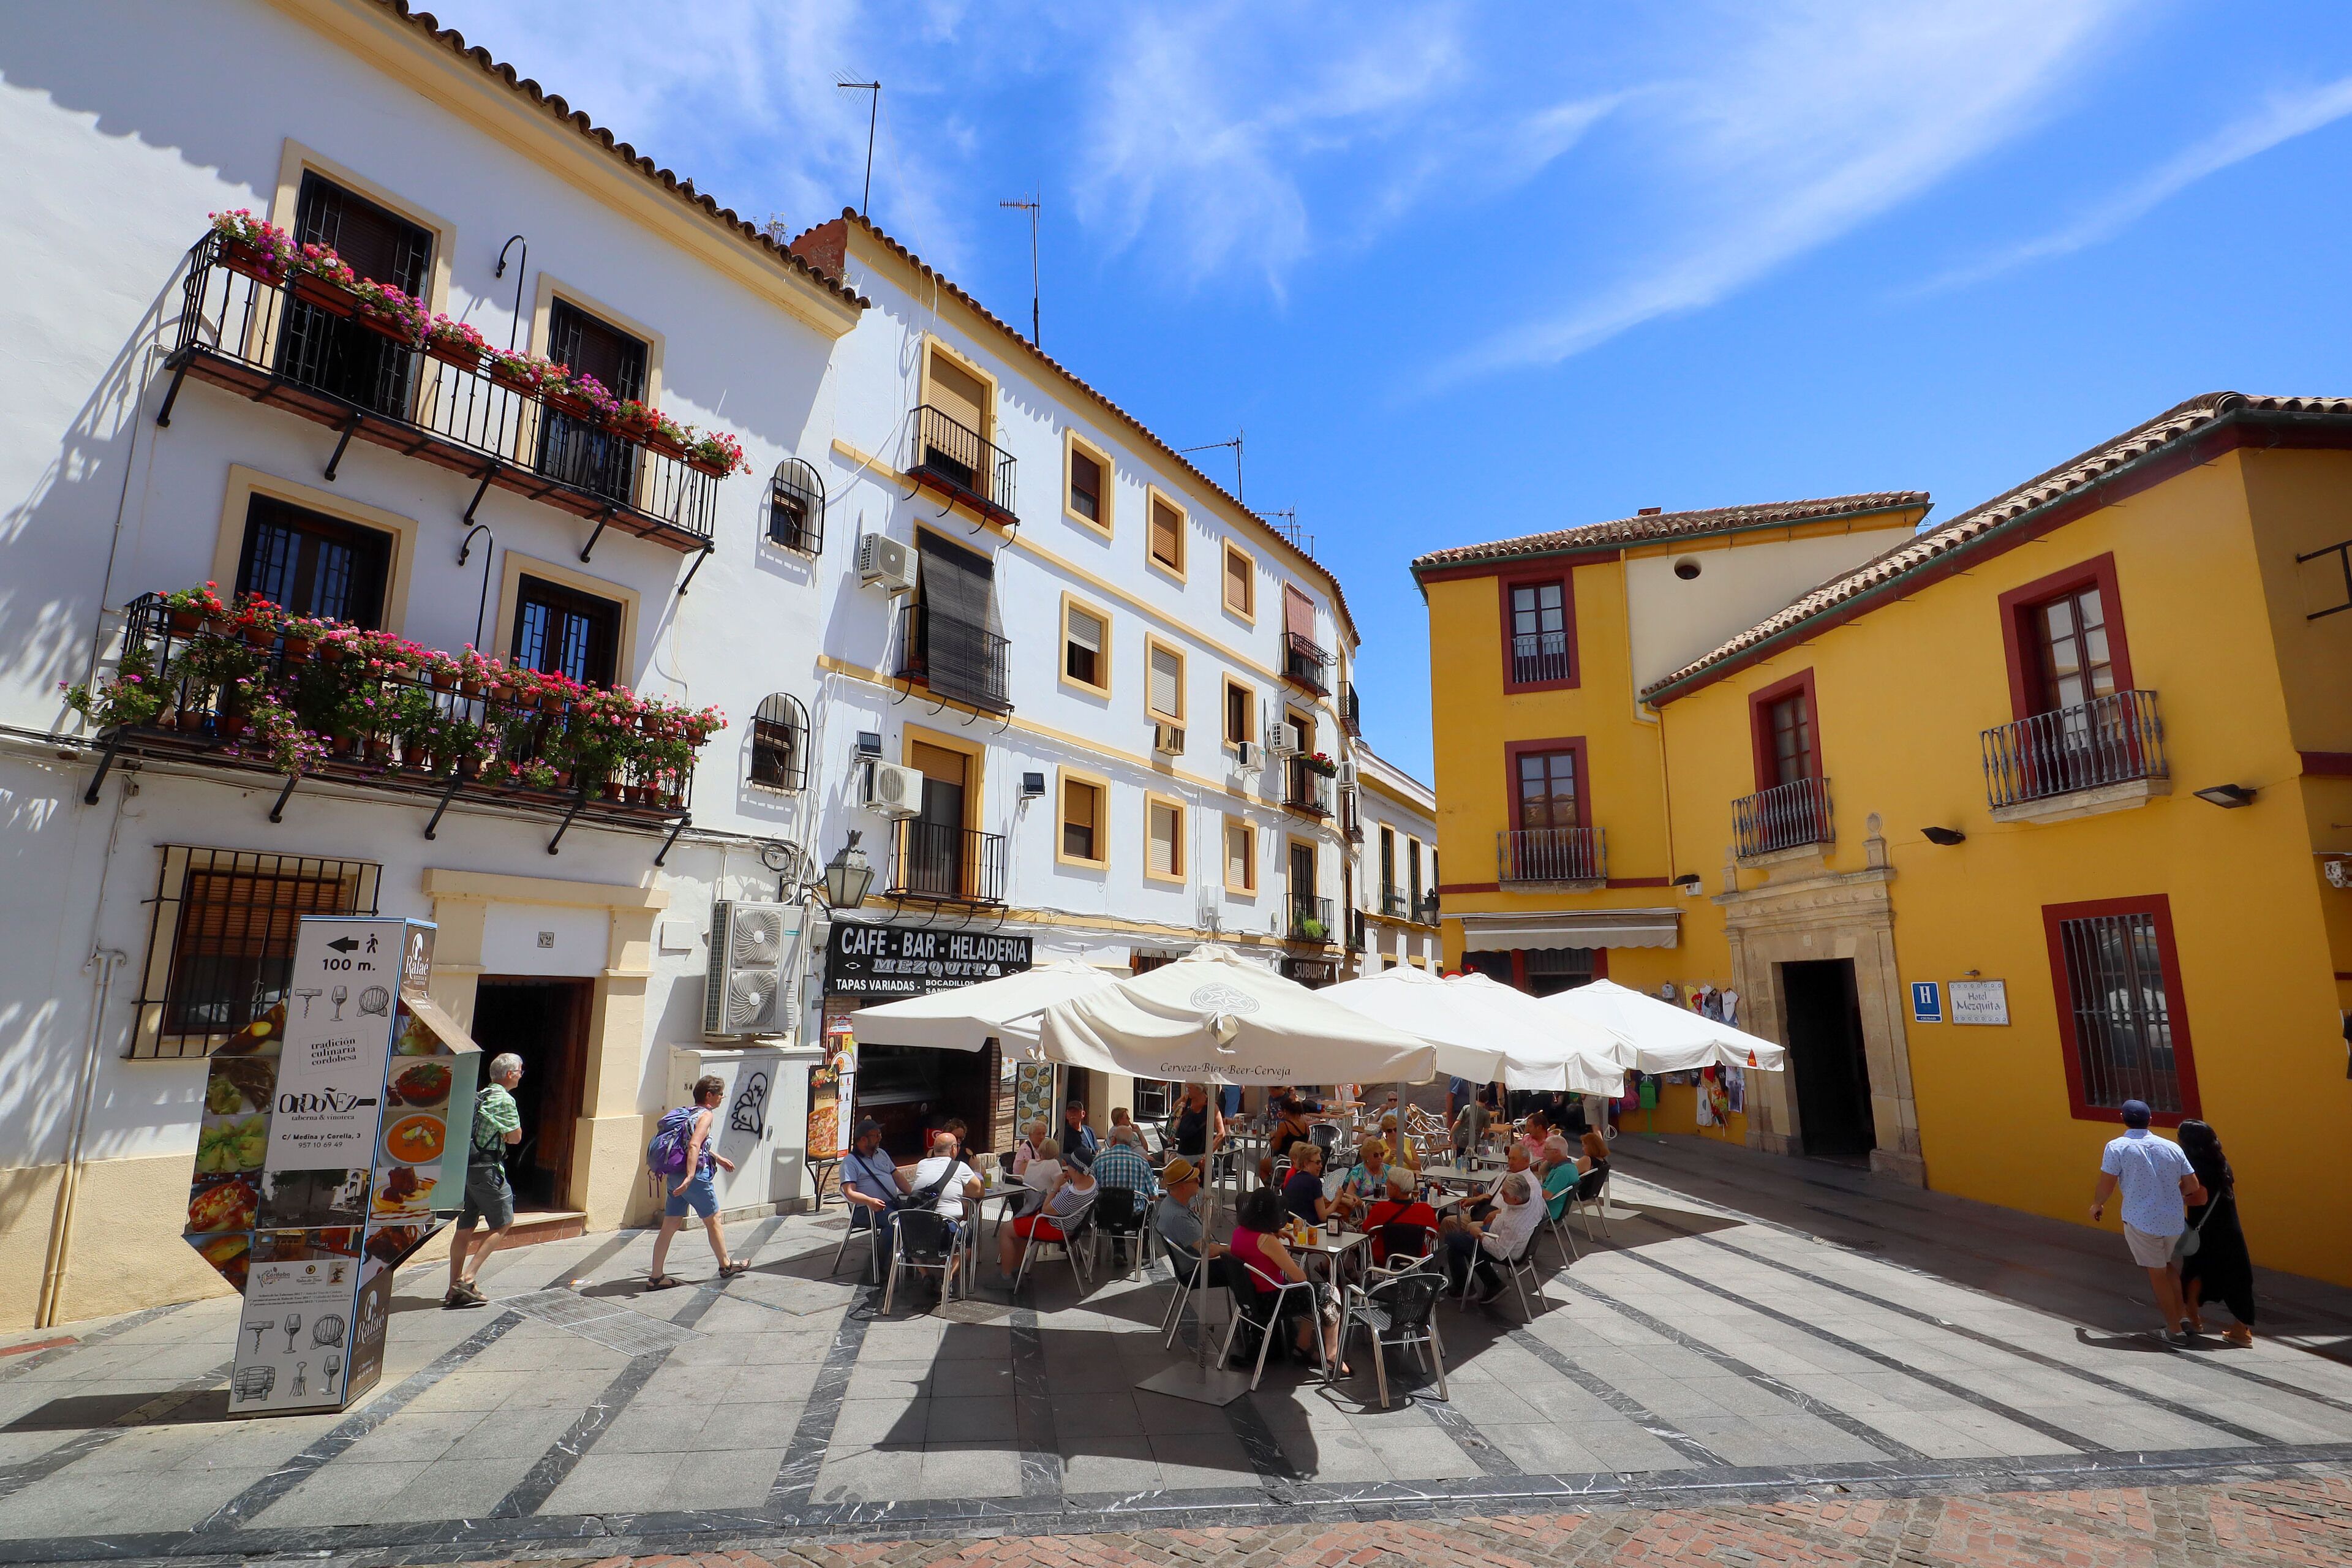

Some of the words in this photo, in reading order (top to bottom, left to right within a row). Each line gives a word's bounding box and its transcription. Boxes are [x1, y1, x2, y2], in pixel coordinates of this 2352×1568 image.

[841, 927, 888, 956] CAFE
[902, 932, 937, 959] BAR
[950, 935, 1028, 963] HELADERIA
[323, 959, 352, 970] 100
[358, 962, 375, 971] m.
[405, 956, 429, 979] Rafaé
[871, 958, 1001, 978] MEZQUITA
[1294, 962, 1330, 979] SUBWAY
[836, 979, 867, 990] TAPAS
[869, 979, 915, 992] VARIADAS
[1919, 986, 1932, 1004] H
[1968, 991, 1987, 1000] Hotel
[1956, 1000, 2001, 1013] Mezquita
[311, 1037, 356, 1050] tradición
[311, 1045, 356, 1058] culinaria
[311, 1055, 357, 1066] cordobesa
[279, 1087, 376, 1114] ORDOÑEZ
[356, 1308, 385, 1344] Rafaé
